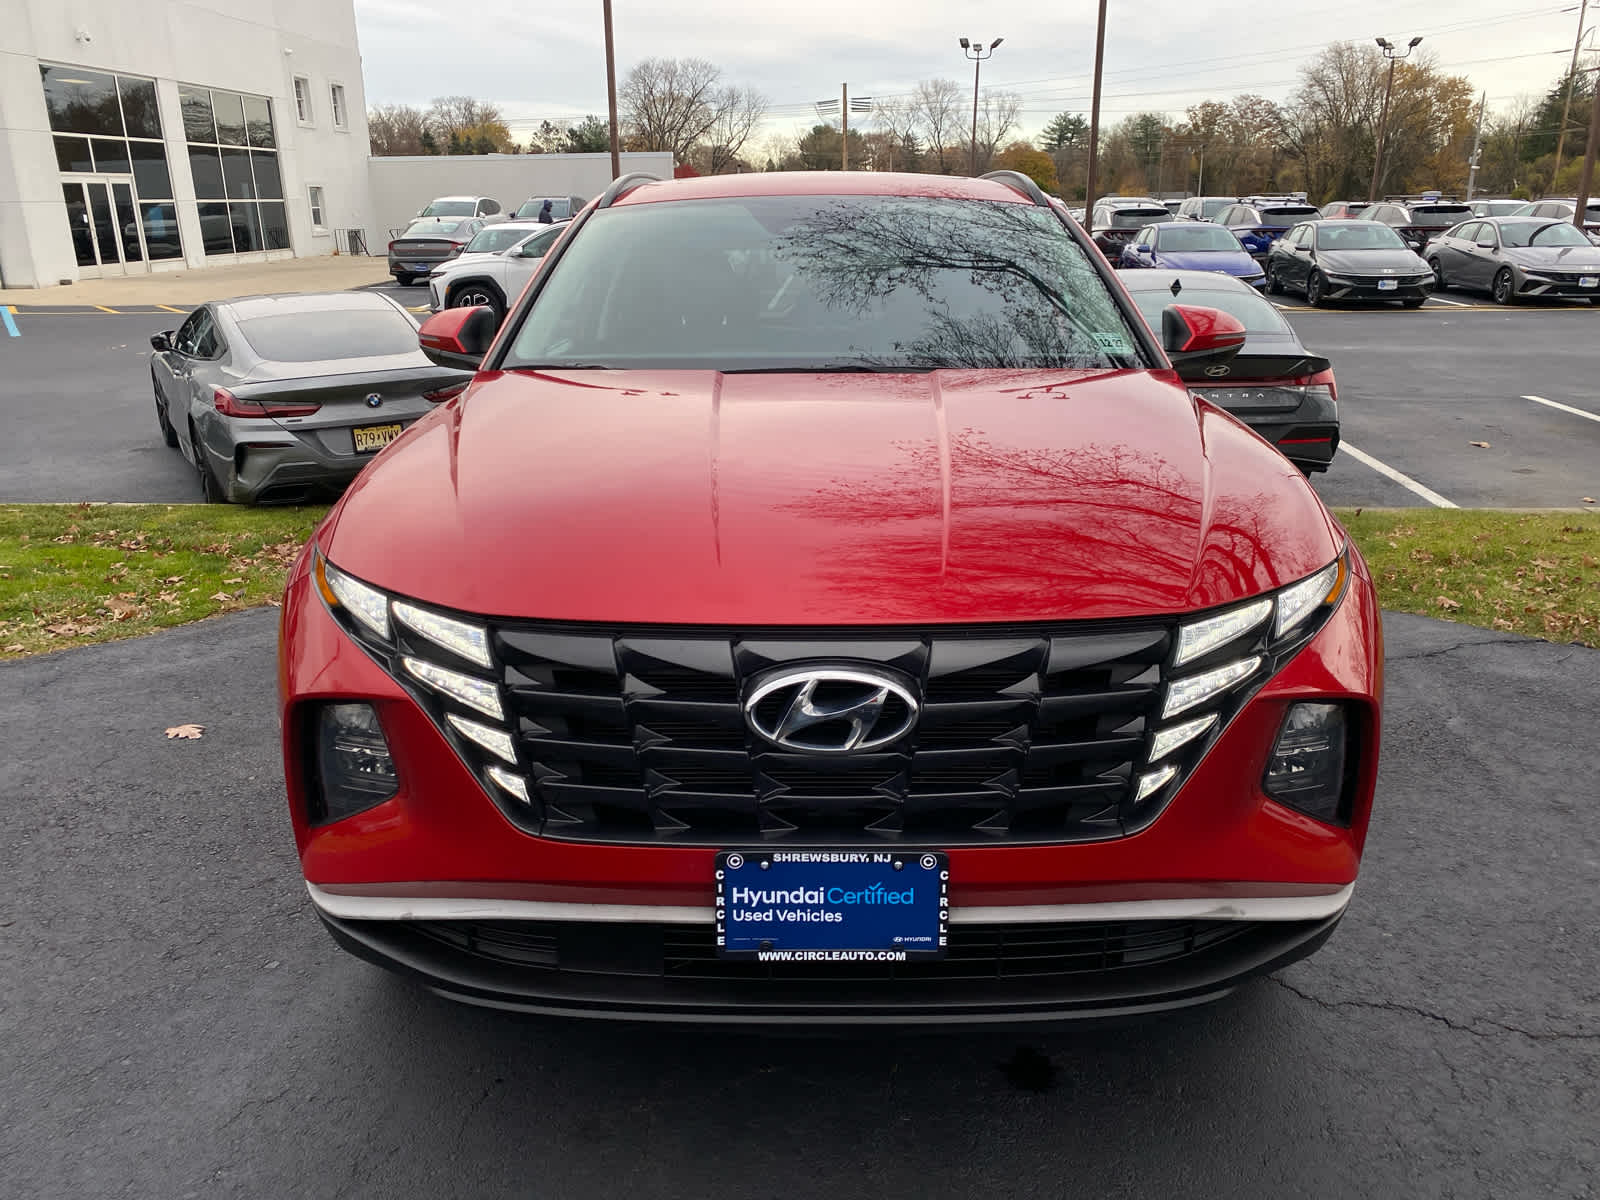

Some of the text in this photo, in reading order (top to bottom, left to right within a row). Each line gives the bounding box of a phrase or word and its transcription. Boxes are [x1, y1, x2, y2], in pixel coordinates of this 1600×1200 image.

[773, 853, 892, 863] SHREWSBURY, NJ
[732, 883, 914, 907] Hyundai Certified
[715, 870, 726, 946] CIRCLE
[733, 909, 843, 922] Used Vehicles
[939, 870, 950, 946] CIRCLE
[758, 952, 907, 962] WWW.CIRCLEAUTO.COM
